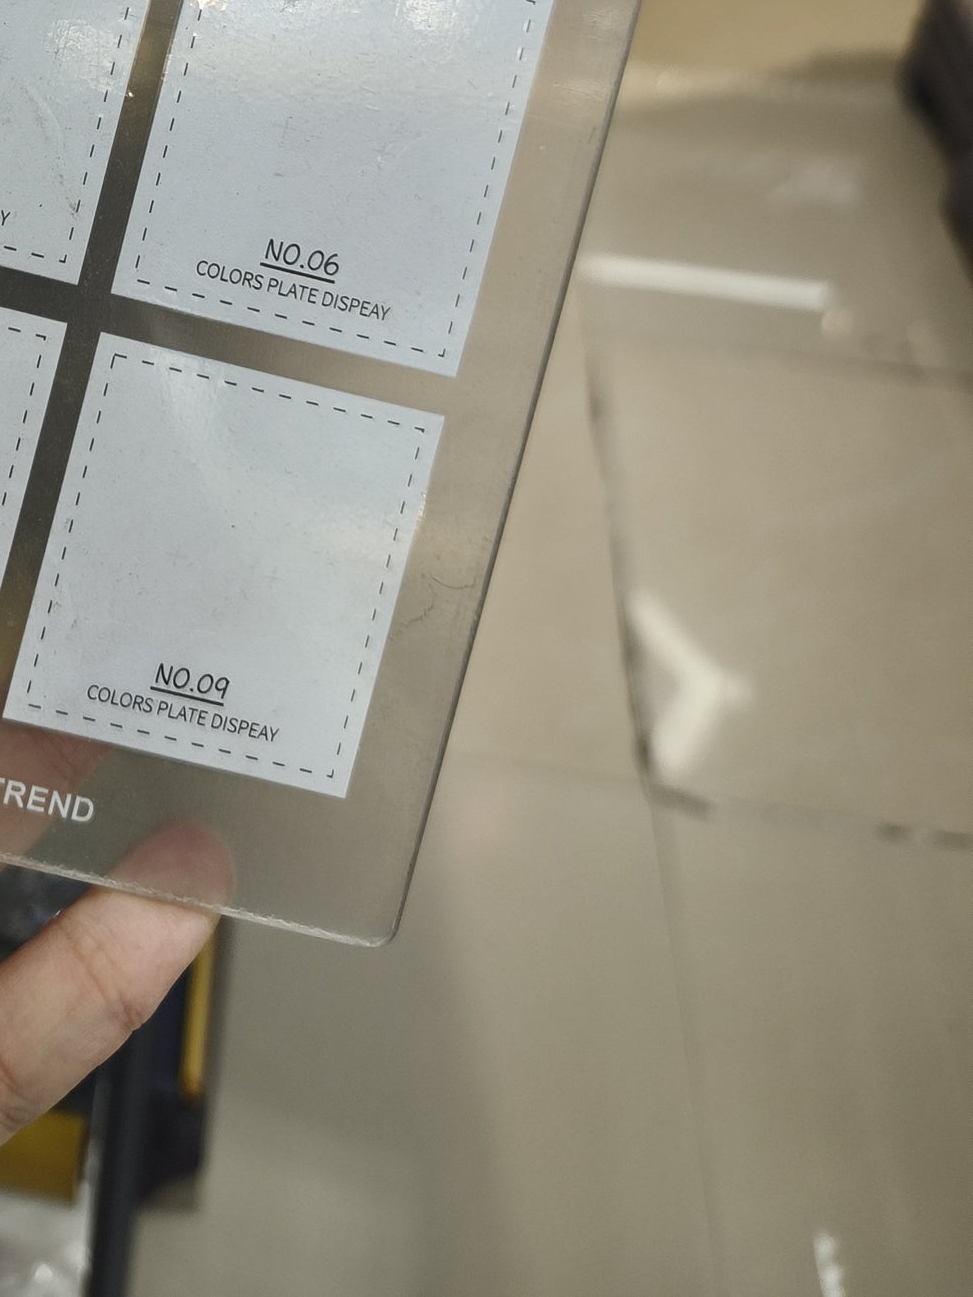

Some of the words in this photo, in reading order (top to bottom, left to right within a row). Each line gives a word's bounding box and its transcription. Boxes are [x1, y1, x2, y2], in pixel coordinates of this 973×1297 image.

[264, 238, 340, 276] NO.06
[196, 260, 264, 290] COLORS
[266, 277, 319, 304] PLATE
[321, 291, 391, 321] DISPEAY
[155, 663, 230, 699] NO.09
[87, 684, 153, 713] COLORS
[157, 700, 209, 726] PLATE
[210, 713, 281, 743] DISPEAY
